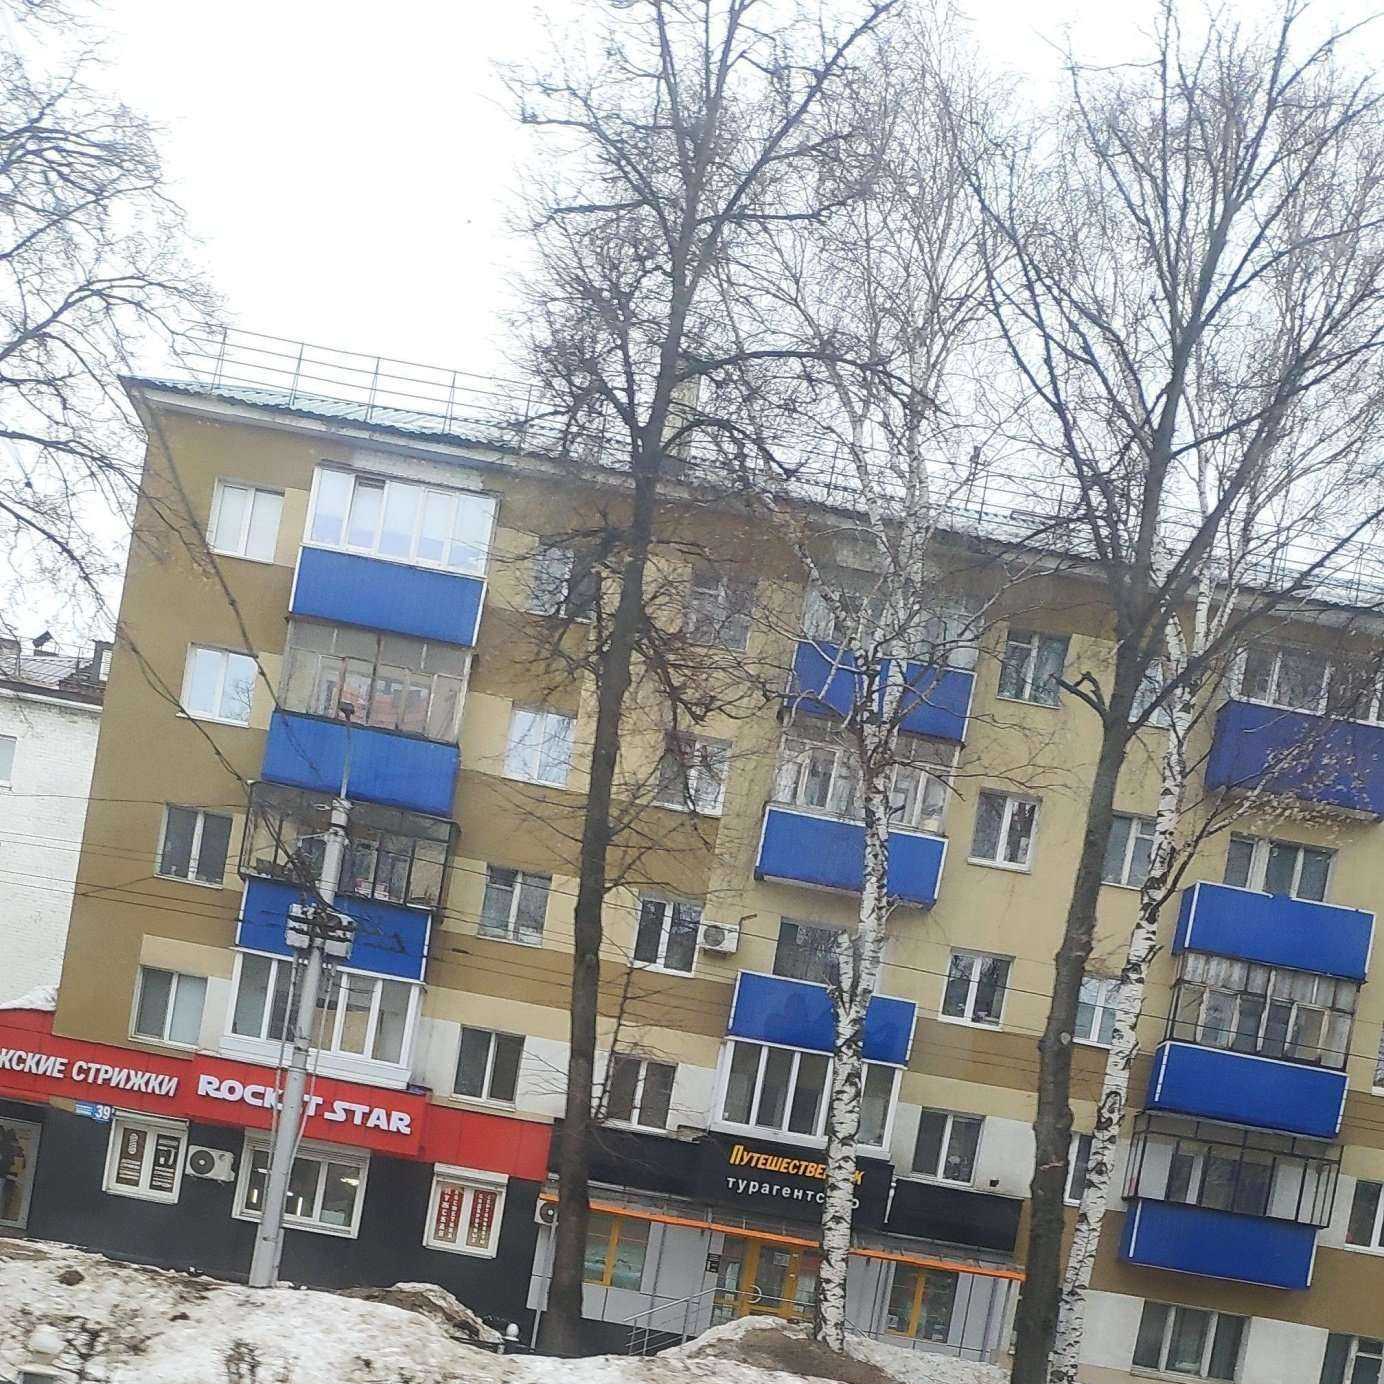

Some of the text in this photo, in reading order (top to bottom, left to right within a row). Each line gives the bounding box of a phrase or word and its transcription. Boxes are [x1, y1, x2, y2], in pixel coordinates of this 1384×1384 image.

[72, 1061, 178, 1097] СТРИЖКИ
[94, 1103, 111, 1120] 39
[197, 1074, 411, 1135] ROCKT STAR
[730, 1144, 864, 1184] ПУТЕШЕСТВЕК
[727, 1177, 860, 1209] турагентсо
